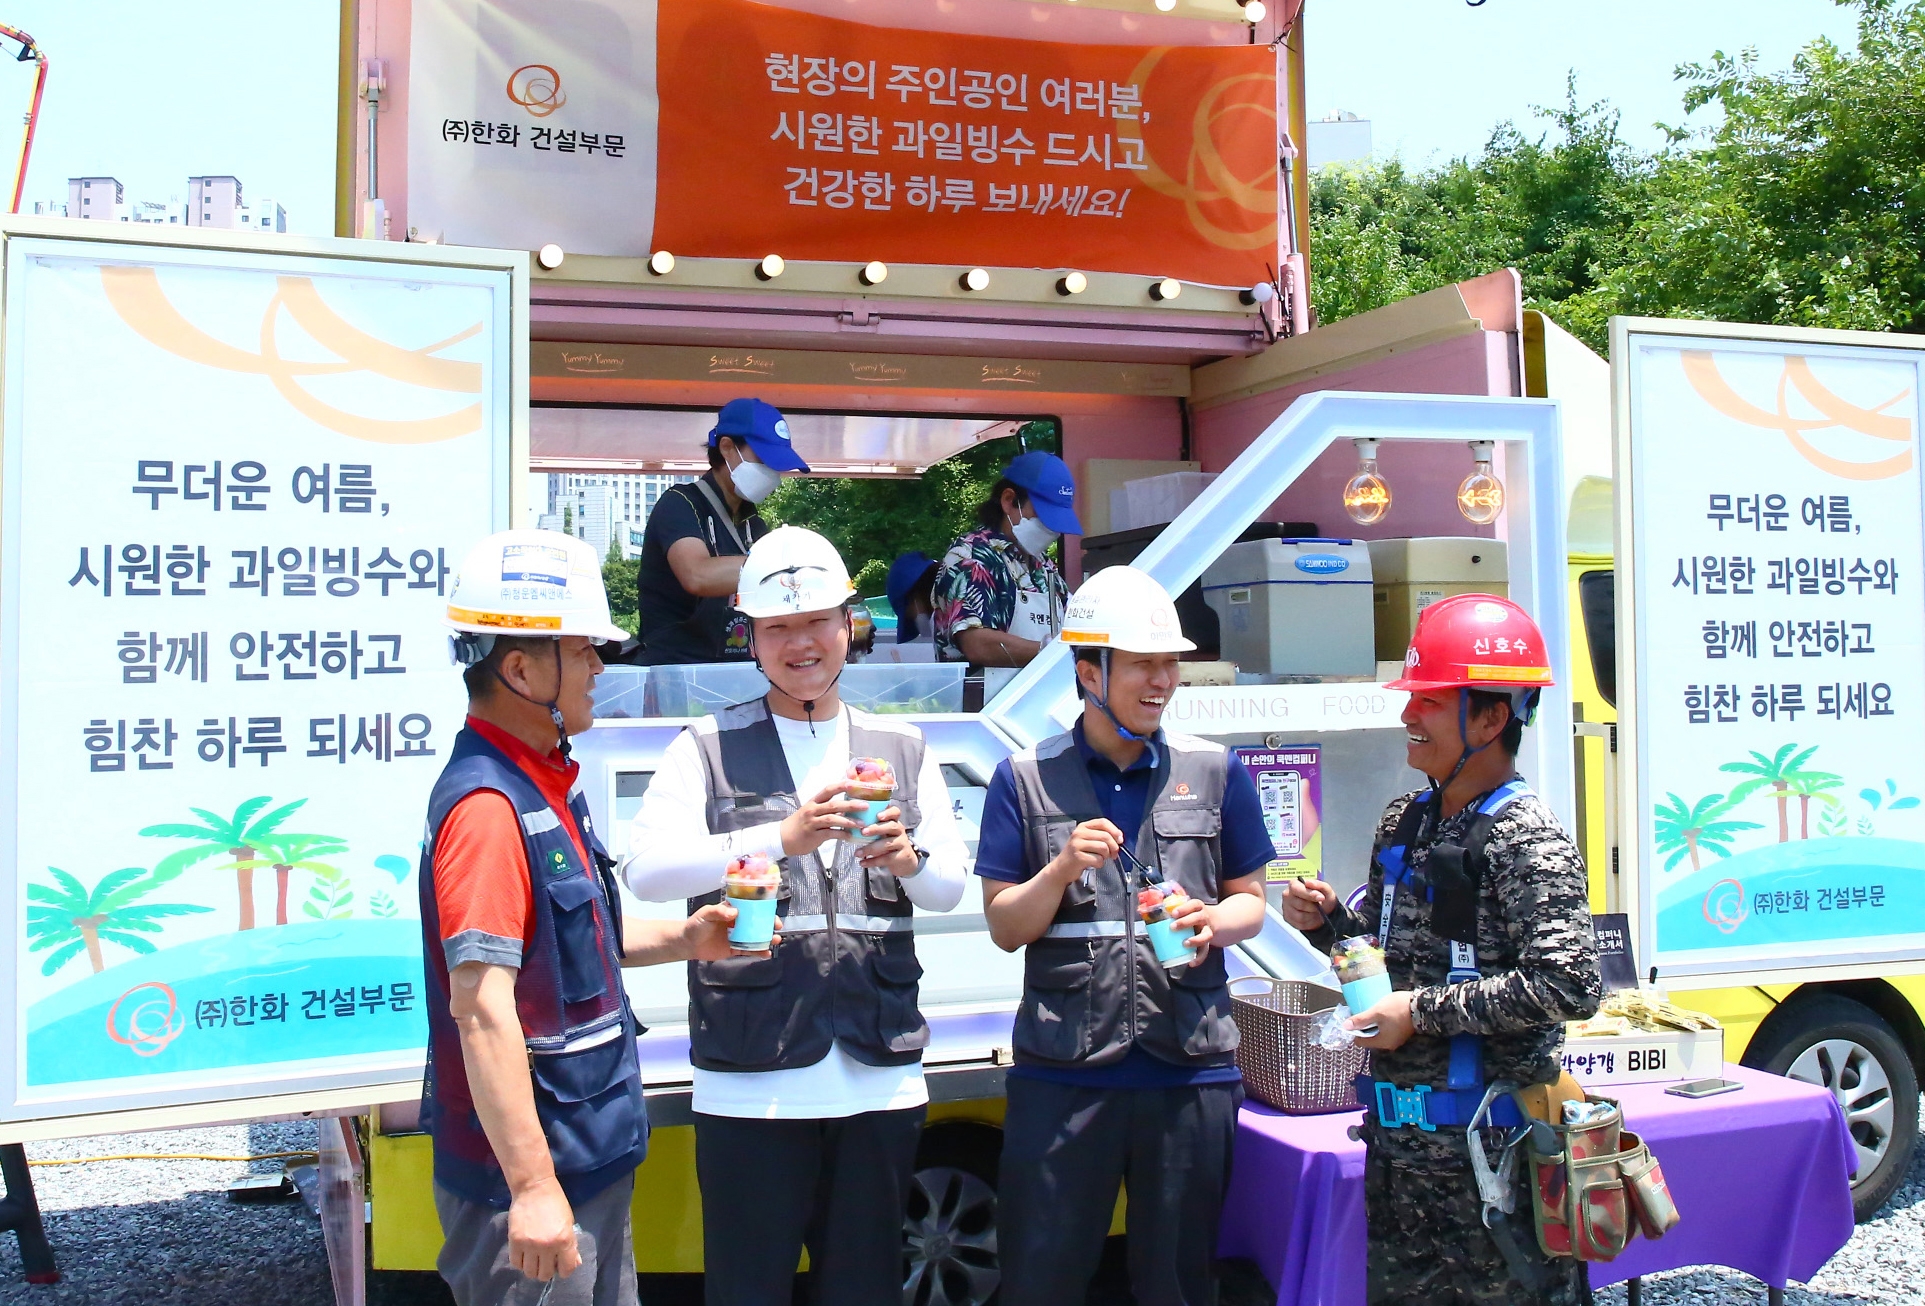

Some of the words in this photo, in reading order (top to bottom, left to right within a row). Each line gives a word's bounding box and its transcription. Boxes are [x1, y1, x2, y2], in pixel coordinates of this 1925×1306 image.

[764, 52, 877, 100] 현장의
[885, 64, 1029, 112] 주인공인
[1040, 75, 1151, 124] 여러분,
[442, 118, 521, 147] (주)한화
[529, 126, 626, 158] 건설부문
[770, 110, 883, 156] 시원한
[892, 119, 1036, 166] 과일빙수
[1043, 131, 1149, 171] 드시고
[783, 166, 896, 212] 건강한
[905, 175, 977, 214] 하루
[981, 182, 1132, 219] 보내세요!
[561, 352, 593, 365] Yummy
[594, 353, 625, 366] Yummy
[709, 355, 739, 367] Sweet
[744, 355, 775, 368] Sweet
[849, 362, 878, 374] Yummy
[880, 363, 907, 375] Yummy
[981, 364, 1010, 377] Sweet
[1013, 364, 1043, 377] Sweet
[132, 460, 271, 511] 무더운
[291, 463, 390, 517] 여름,
[1706, 493, 1790, 532] 무더운
[1801, 495, 1861, 535] 여름,
[68, 543, 211, 597] 시원한
[228, 545, 451, 598] 과일빙수와
[1672, 555, 1756, 595] 시원한
[1766, 556, 1899, 596] 과일빙수와
[116, 631, 208, 684] 함께
[229, 629, 407, 681] 안전하고
[1472, 637, 1528, 656] 신호수
[1702, 620, 1757, 659] 함께
[1768, 619, 1875, 658] 안전하고
[1322, 694, 1386, 716] FOOD
[1684, 683, 1741, 724] 힘찬
[1751, 683, 1806, 722] 하루
[1816, 681, 1895, 720] 되세요
[83, 718, 179, 773] 힘찬
[196, 716, 287, 769] 하루
[306, 712, 437, 764] 되세요
[1241, 755, 1250, 766] 내
[1251, 754, 1275, 765] 손안의
[1753, 889, 1810, 916] (주)한화
[1816, 884, 1886, 911] 건설부문
[1596, 929, 1622, 940] 컴퍼니
[194, 992, 289, 1030] (주)한화
[301, 982, 416, 1021] 건설부문
[1628, 1049, 1667, 1071] BIBI
